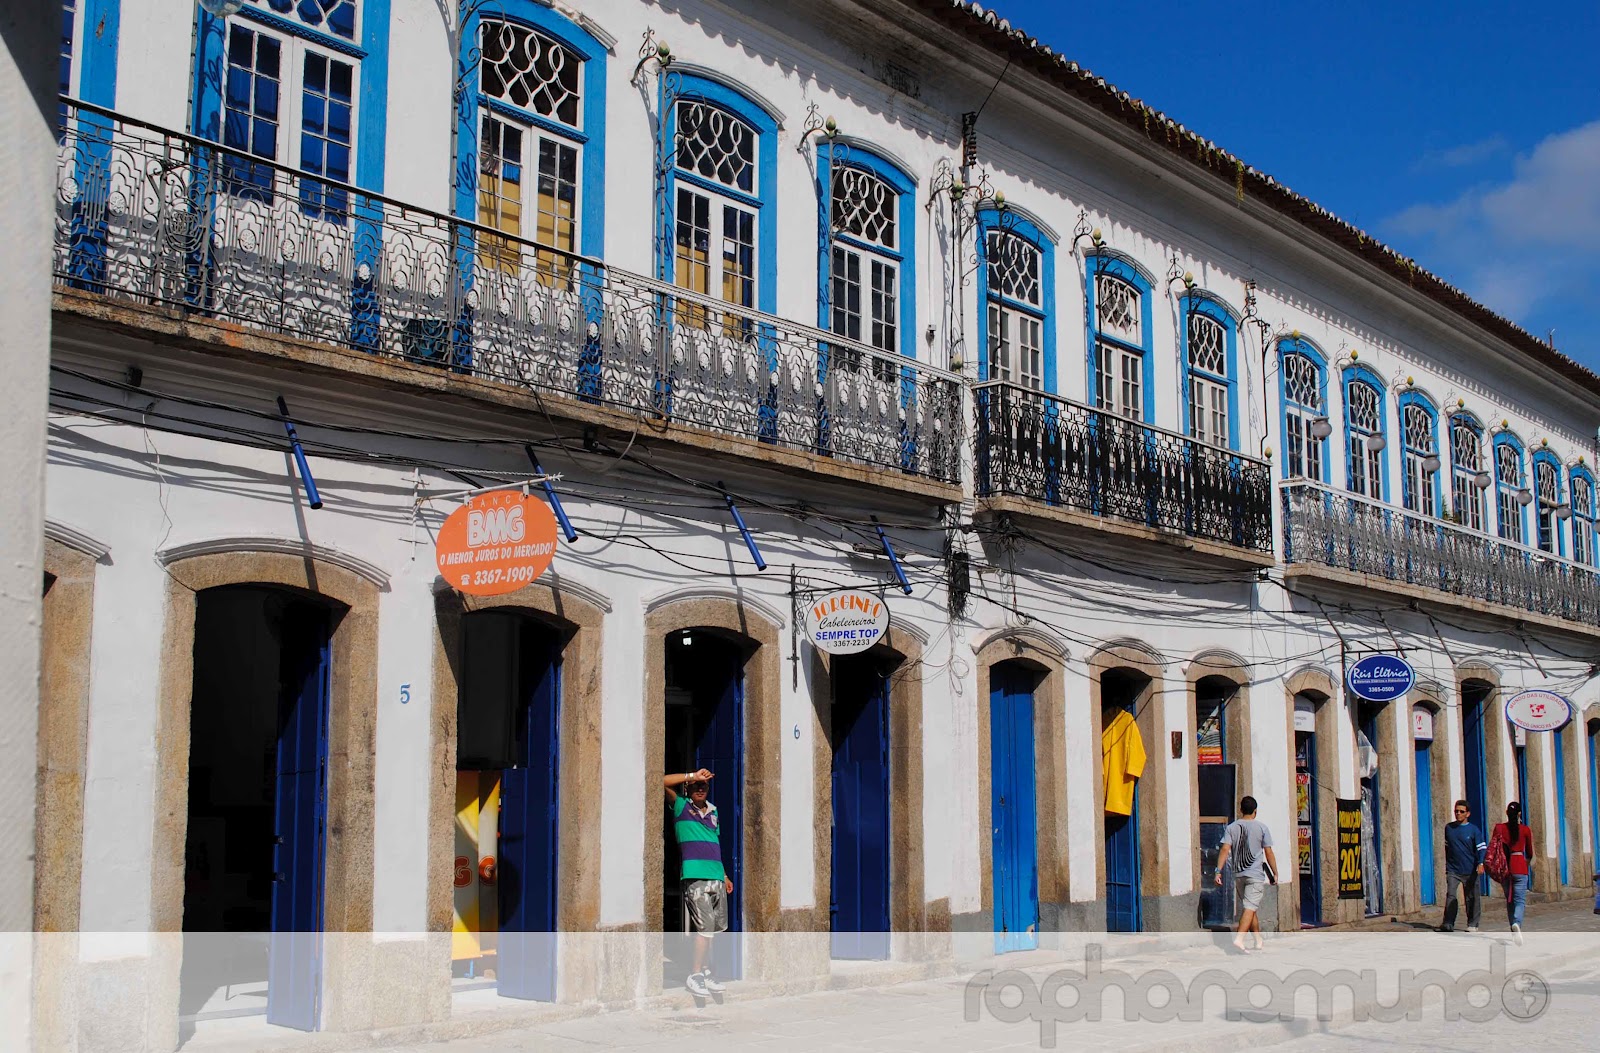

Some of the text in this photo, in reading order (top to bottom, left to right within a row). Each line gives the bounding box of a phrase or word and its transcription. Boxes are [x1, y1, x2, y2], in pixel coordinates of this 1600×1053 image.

[468, 494, 524, 509] BANCO
[467, 505, 525, 548] BMG
[440, 541, 554, 565] O MENOR JUROS DO MERCADO!
[474, 565, 534, 586] 3367-1909
[813, 595, 883, 622] JORGINHO
[819, 616, 876, 630] Cabeleireiros
[815, 628, 879, 641] SEMPRE TOP
[833, 638, 870, 648] 3367-2233
[1353, 667, 1371, 679] Reis
[400, 684, 410, 704] 5
[1509, 695, 1526, 709] MUNDO
[1538, 693, 1567, 711] UTILIDADES
[793, 724, 800, 739] 6
[1340, 845, 1361, 882] 20%
